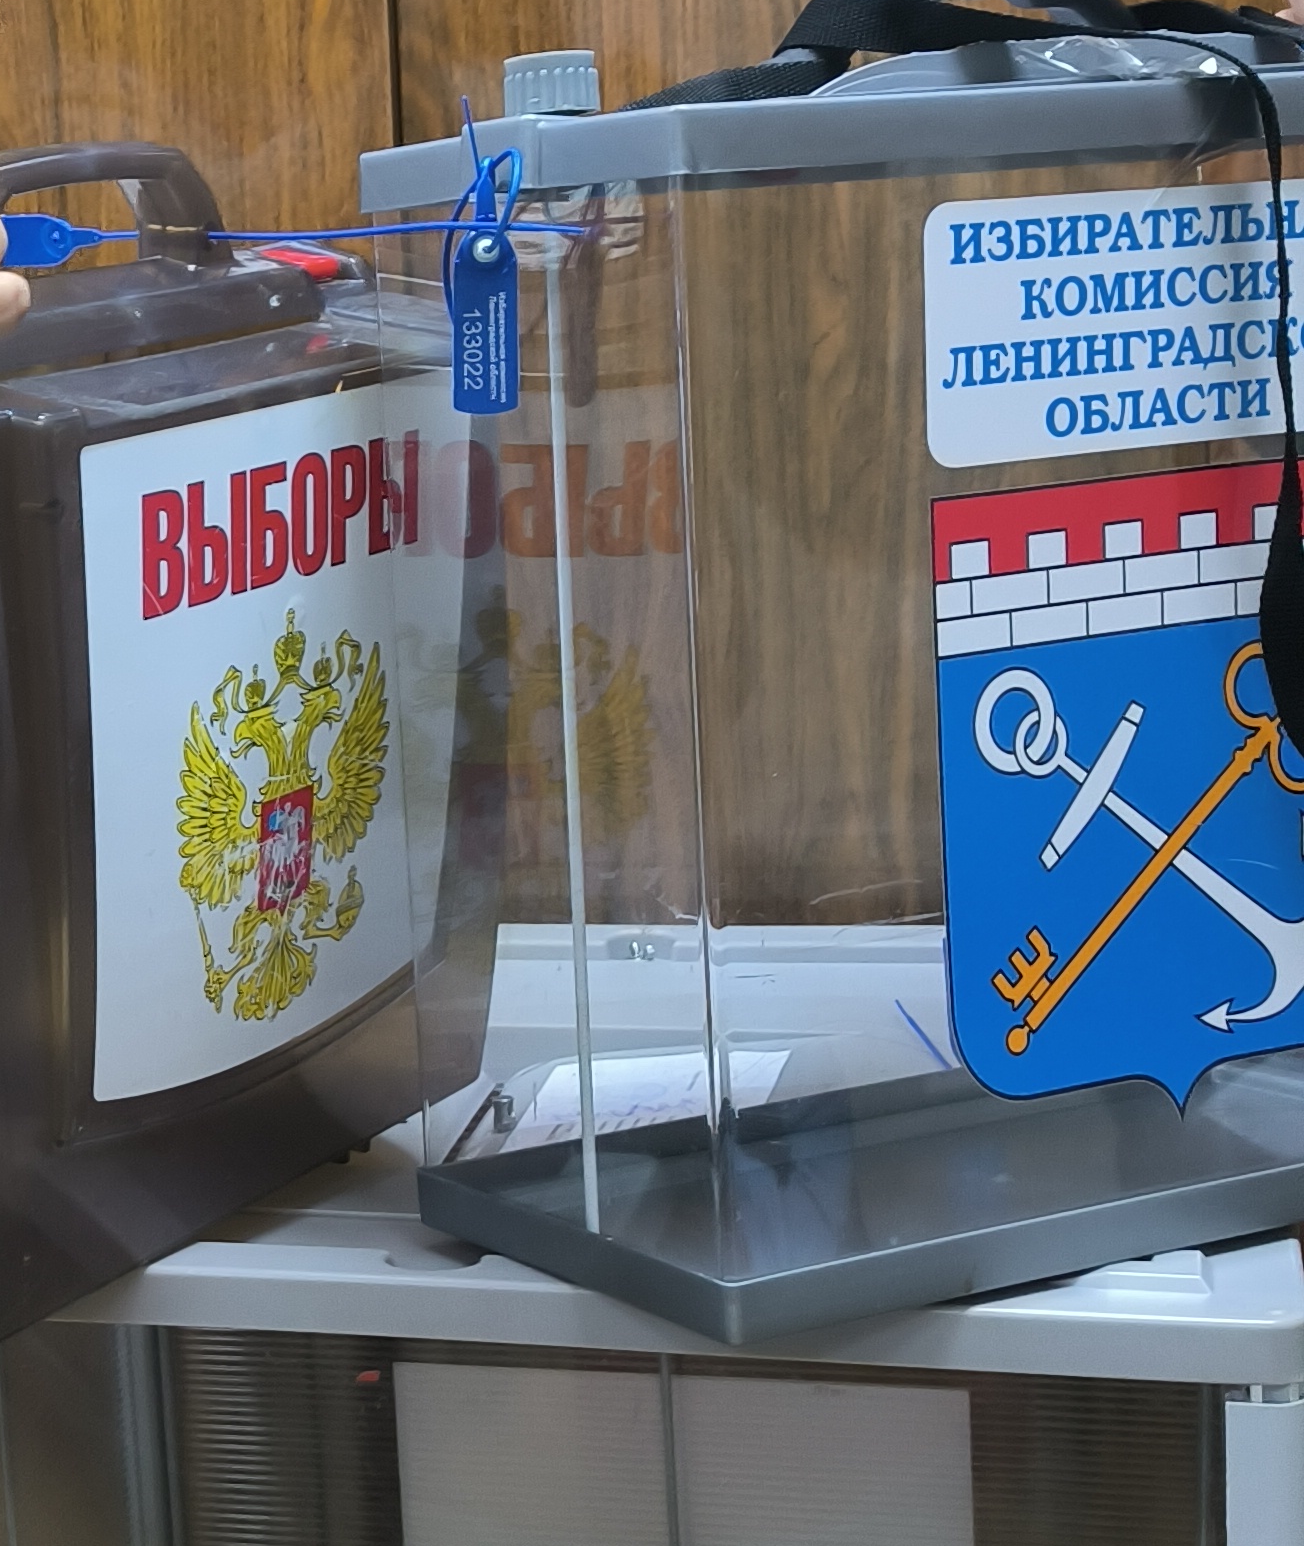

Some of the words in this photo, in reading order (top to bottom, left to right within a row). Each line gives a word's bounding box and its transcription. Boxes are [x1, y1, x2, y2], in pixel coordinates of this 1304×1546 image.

[949, 199, 1304, 265] ИЗБИРАТЕЛЬН
[1020, 257, 1294, 321] КОМИССИЯ
[462, 309, 483, 390] 133022
[942, 315, 1304, 390] ЛЕНИНГРАДСК
[1045, 377, 1271, 438] ОБЛАСТИ
[141, 429, 419, 621] ВЫБОРЫ
